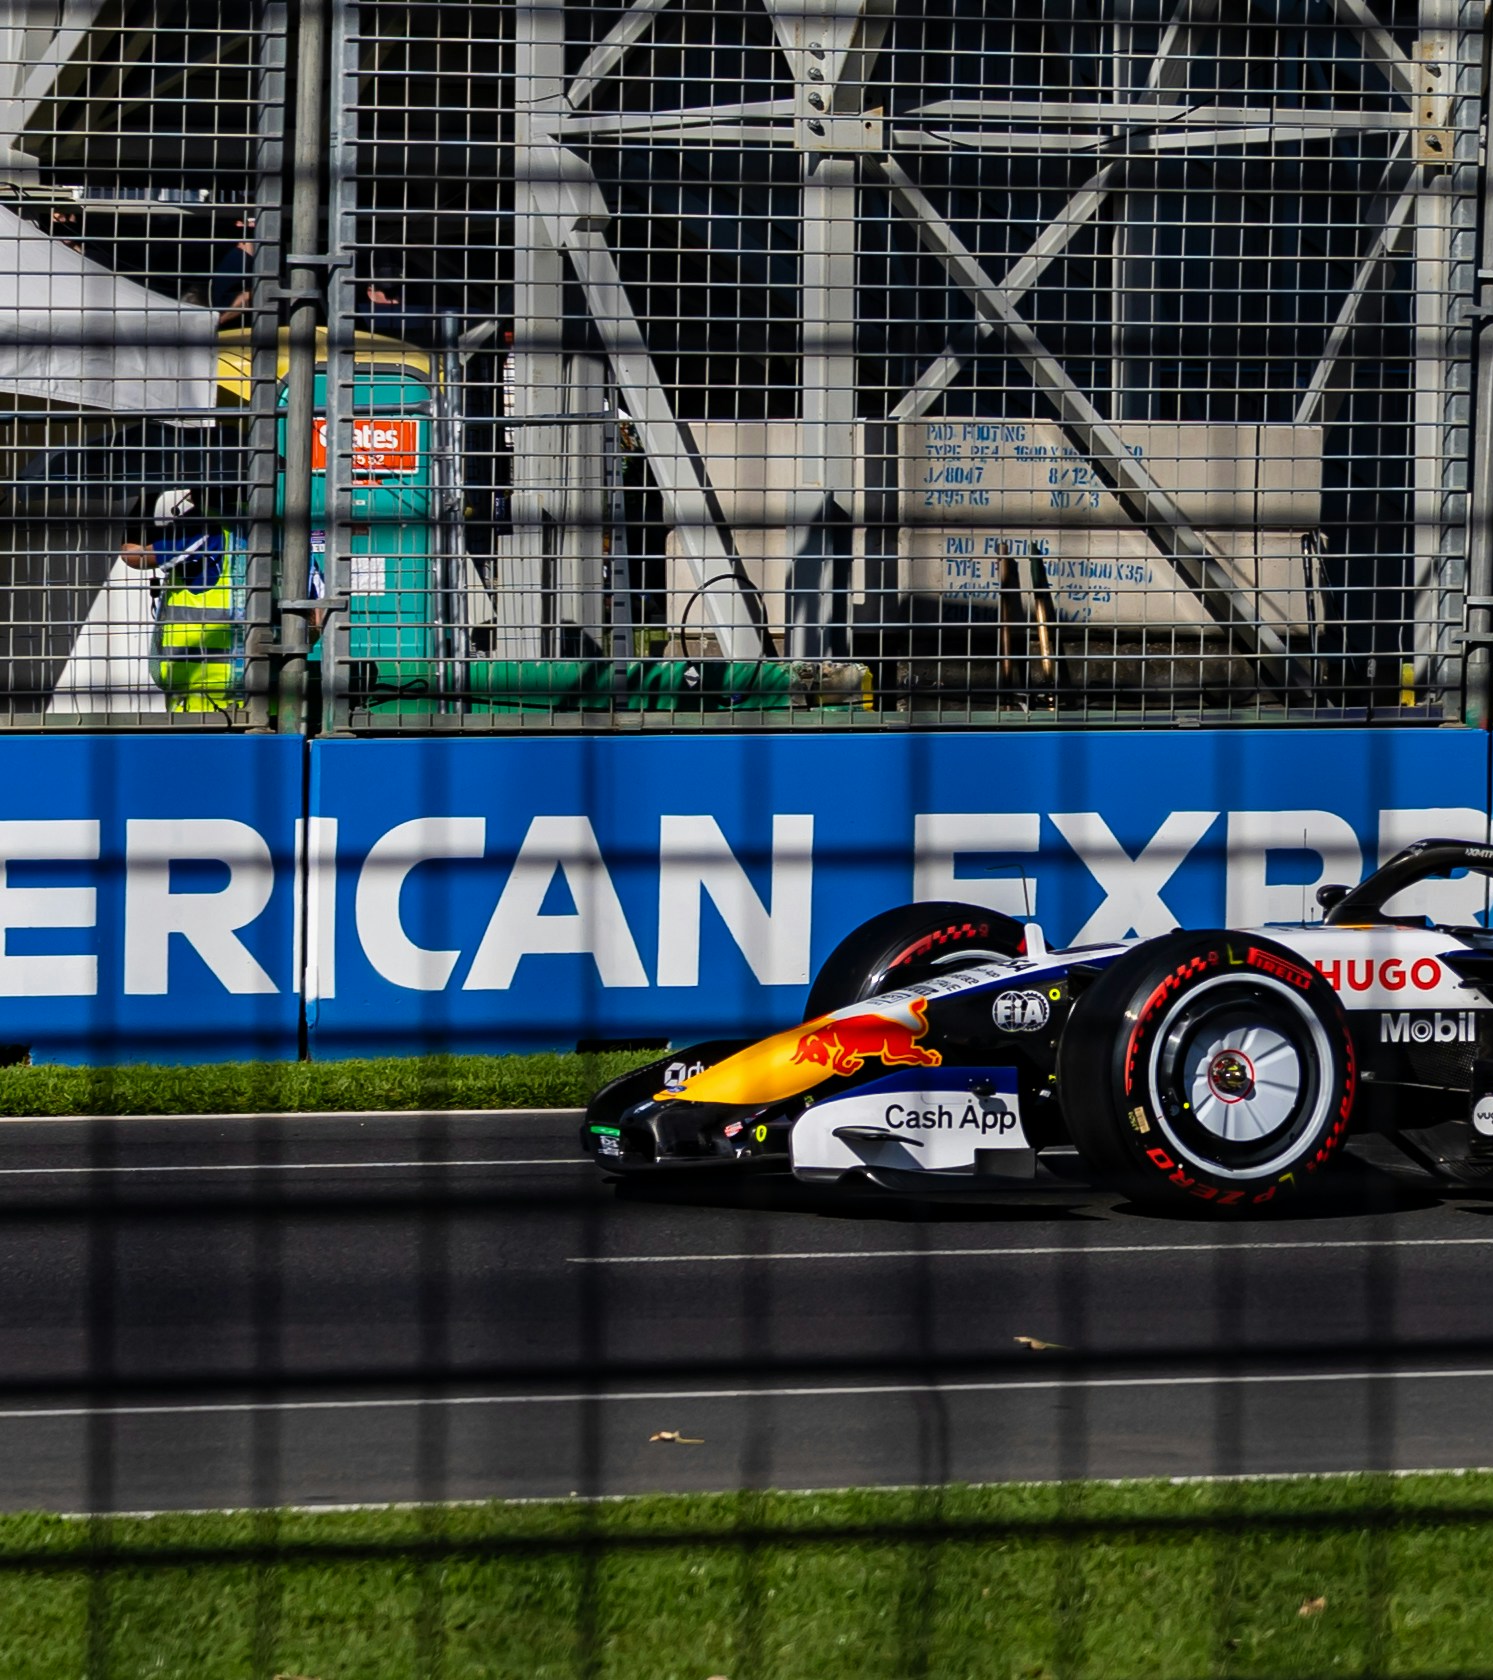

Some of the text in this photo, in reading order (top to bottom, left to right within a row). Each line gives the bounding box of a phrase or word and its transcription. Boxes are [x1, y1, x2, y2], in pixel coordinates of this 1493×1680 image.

[319, 425, 399, 449] ates
[927, 425, 954, 441] PAD
[923, 466, 984, 484] J/8047
[946, 537, 1050, 556] PAD FOOTIG
[946, 559, 981, 578] TYPE
[0, 813, 815, 999] ERICAN
[1246, 946, 1314, 991] PIRELLI
[1315, 957, 1442, 992] HUGO
[1380, 1012, 1476, 1043] Mobil
[885, 1102, 1017, 1136] Cash App
